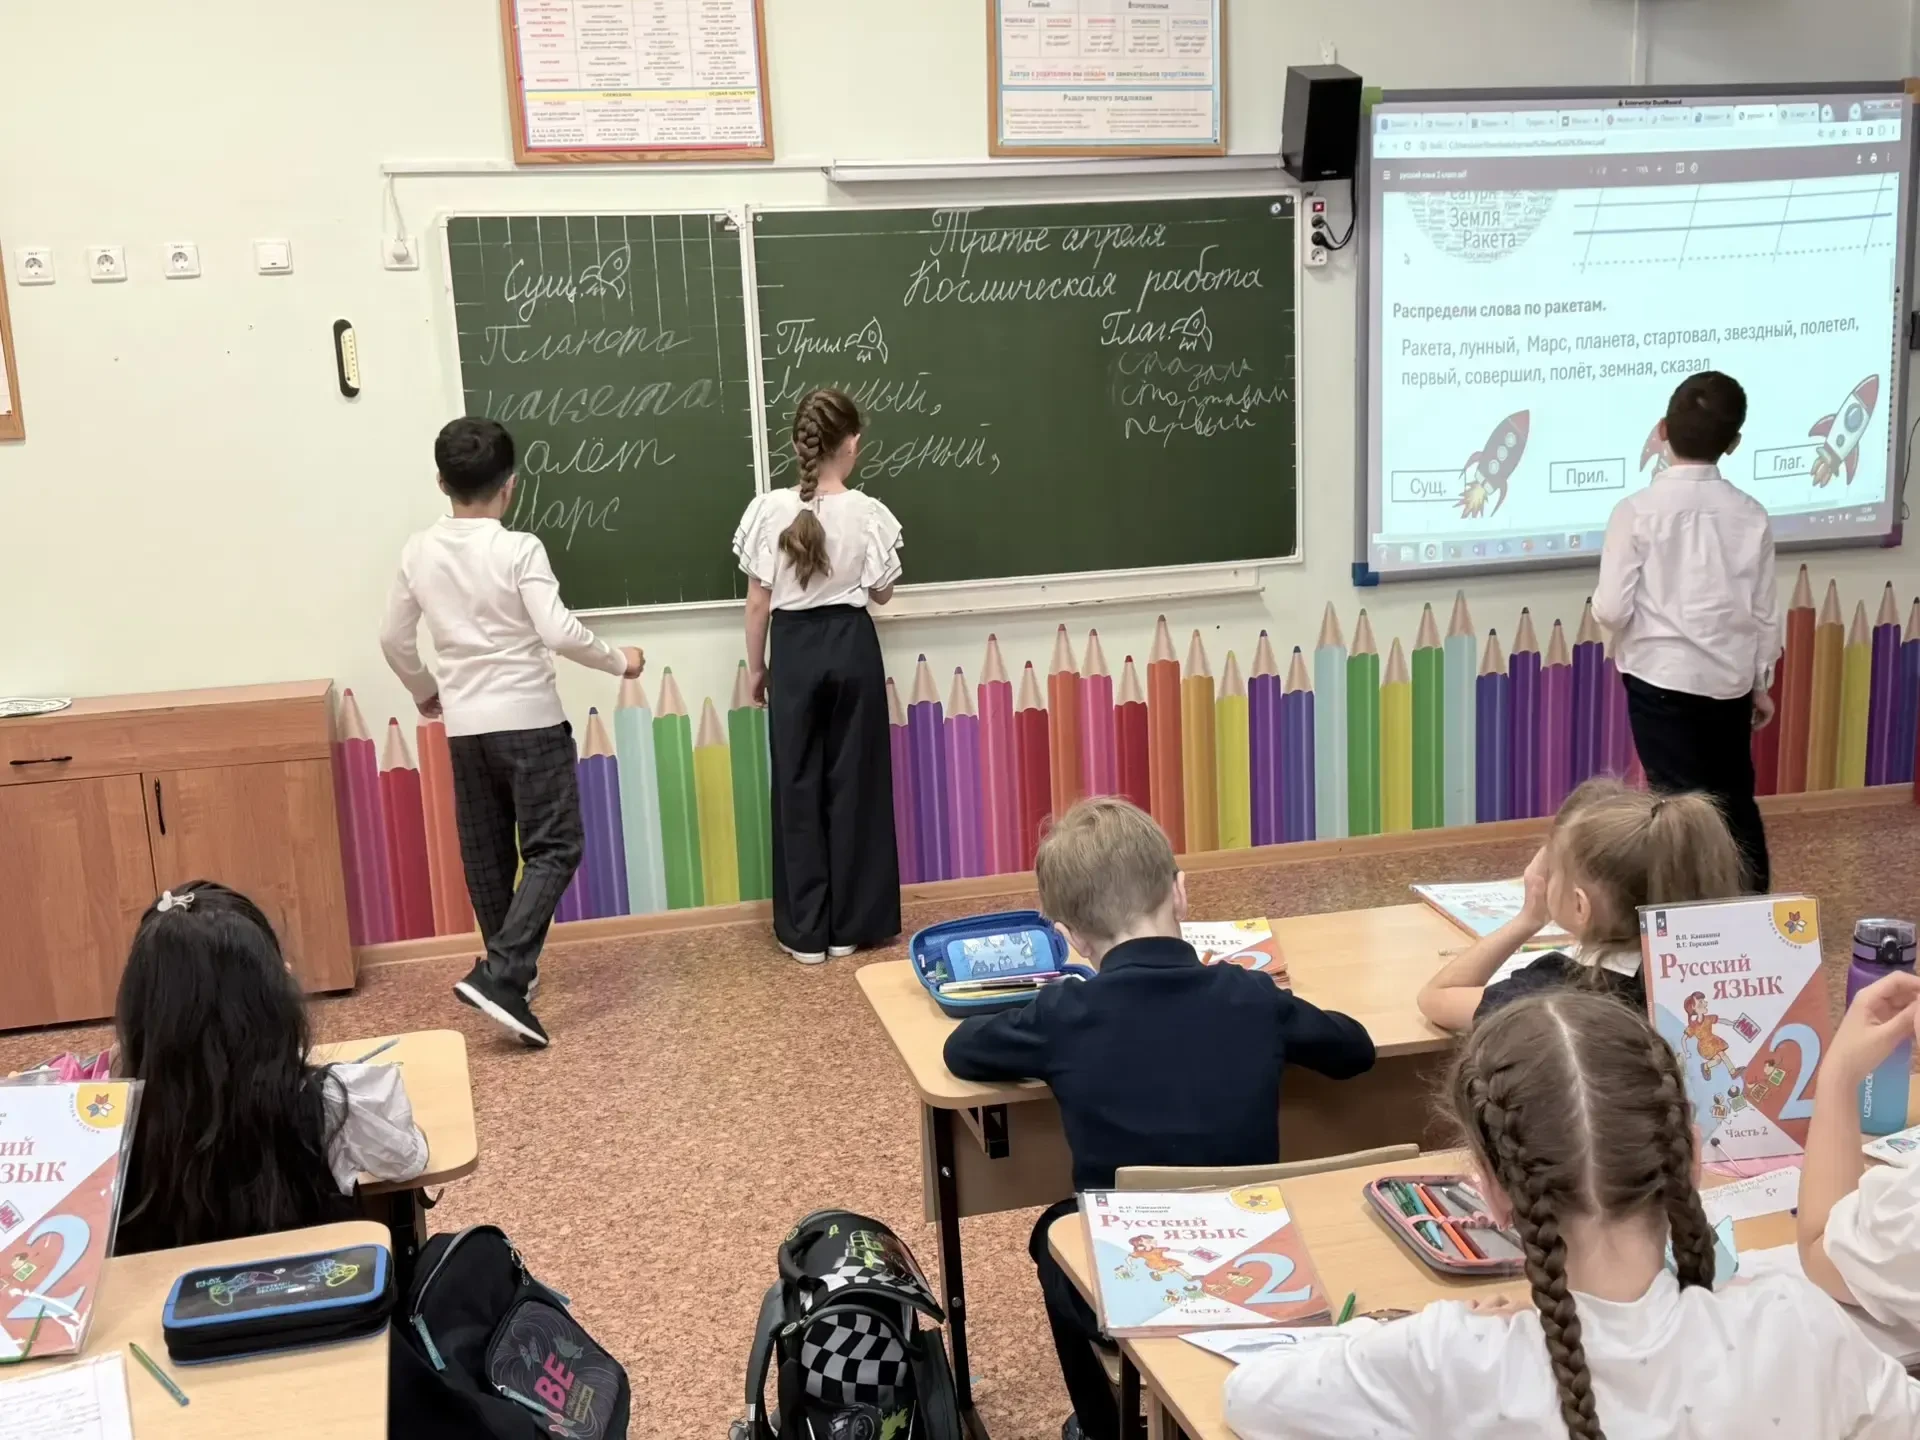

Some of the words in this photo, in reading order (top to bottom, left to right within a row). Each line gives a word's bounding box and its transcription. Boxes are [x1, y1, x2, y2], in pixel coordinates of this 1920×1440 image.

[1449, 206, 1501, 228] Земля
[930, 206, 1051, 277] Третье
[1062, 223, 1166, 270] апреля
[1463, 229, 1516, 249] Ракета
[904, 259, 1116, 307] Космическая
[1137, 245, 1264, 313] работа
[1393, 302, 1477, 321] Распредели
[1480, 302, 1521, 317] слова
[1524, 302, 1542, 315] по
[1544, 300, 1607, 317] ракетам.
[1402, 338, 1456, 358] Ракета,
[1459, 336, 1520, 359] лунный,
[1527, 335, 1572, 356] Марс,
[1575, 332, 1640, 351] планета,
[1643, 328, 1721, 345] стартовал,
[1724, 320, 1797, 341] звездный,
[1800, 316, 1860, 335] полетел,
[1402, 368, 1461, 389] первый,
[1465, 367, 1546, 387] совершил,
[1550, 362, 1596, 381] полёт,
[1599, 360, 1657, 378] земная,
[1660, 358, 1711, 375] сказал
[1565, 466, 1609, 487] Прил.
[1772, 455, 1806, 473] Глаг.
[1410, 477, 1447, 498] Сущ.
[1659, 953, 1752, 983] Русский
[1769, 1023, 1821, 1121] 2
[1725, 1127, 1759, 1139] Часть
[1761, 1126, 1769, 1136] 2
[1099, 1213, 1209, 1231] Русский
[7, 1213, 92, 1320] 2
[1232, 1252, 1314, 1306] 2
[534, 1352, 575, 1412] BE
